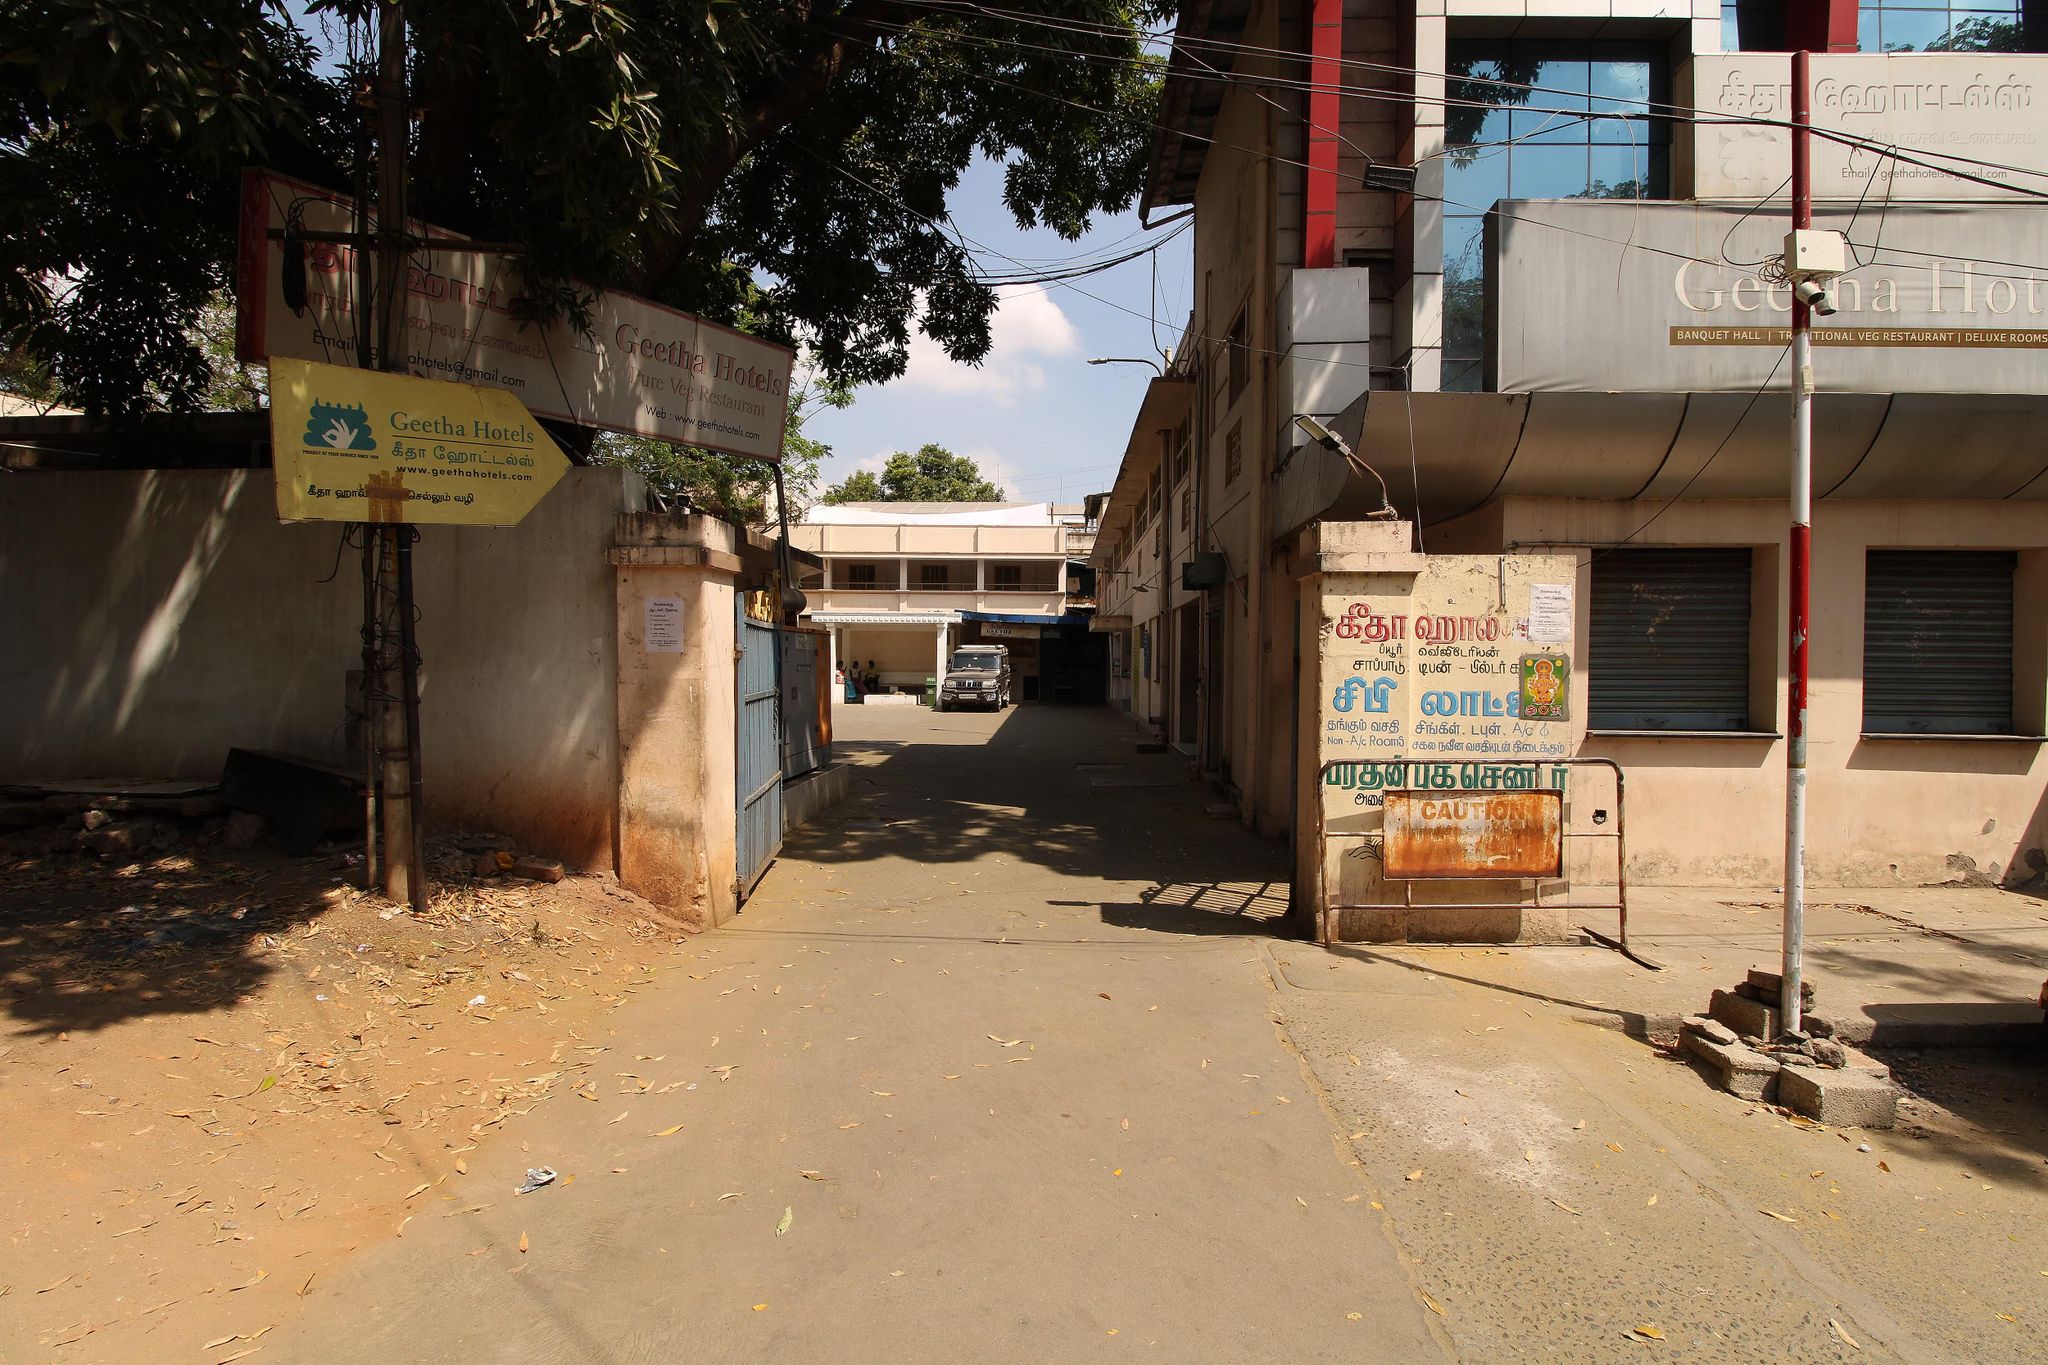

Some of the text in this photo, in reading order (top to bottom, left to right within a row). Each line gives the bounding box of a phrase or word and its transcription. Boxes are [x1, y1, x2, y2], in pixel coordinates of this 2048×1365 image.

[1814, 73, 2033, 121] ஹோட்டல்ஸ்
[1841, 167, 1870, 179] Email
[1675, 257, 1901, 313] Geeha
[313, 329, 357, 351] Email
[1677, 330, 1730, 341] BANQUET
[1733, 330, 1761, 341] HALL
[1779, 331, 1855, 342] TRITIONAL
[1858, 331, 1880, 342] VEG
[1883, 332, 1954, 343] RESTAURANT
[1965, 333, 2006, 343] DELUXE
[2010, 333, 2048, 344] ROOMS
[615, 323, 783, 396] Geetha Hotels
[628, 366, 767, 418] Pure Veg Restaurant
[389, 411, 535, 444] Geetha Hotels
[645, 404, 667, 419] Web
[674, 413, 760, 441] www.geethahotels.com
[390, 441, 535, 468] கீதா ஹோட்டல்ஸ்
[396, 465, 533, 482] www.geethahotels.com
[308, 484, 331, 499] கீதா
[408, 489, 451, 503] செல்லும்
[454, 493, 474, 506] வழி
[1335, 602, 1408, 645] கீதா
[1418, 659, 1452, 676] டிபன்
[1333, 676, 1398, 713] சிபி
[1326, 718, 1367, 733] தங்கும்
[1370, 719, 1401, 734] வசதி
[1412, 741, 1436, 750] சகல
[1420, 800, 1526, 821] CAUTION
